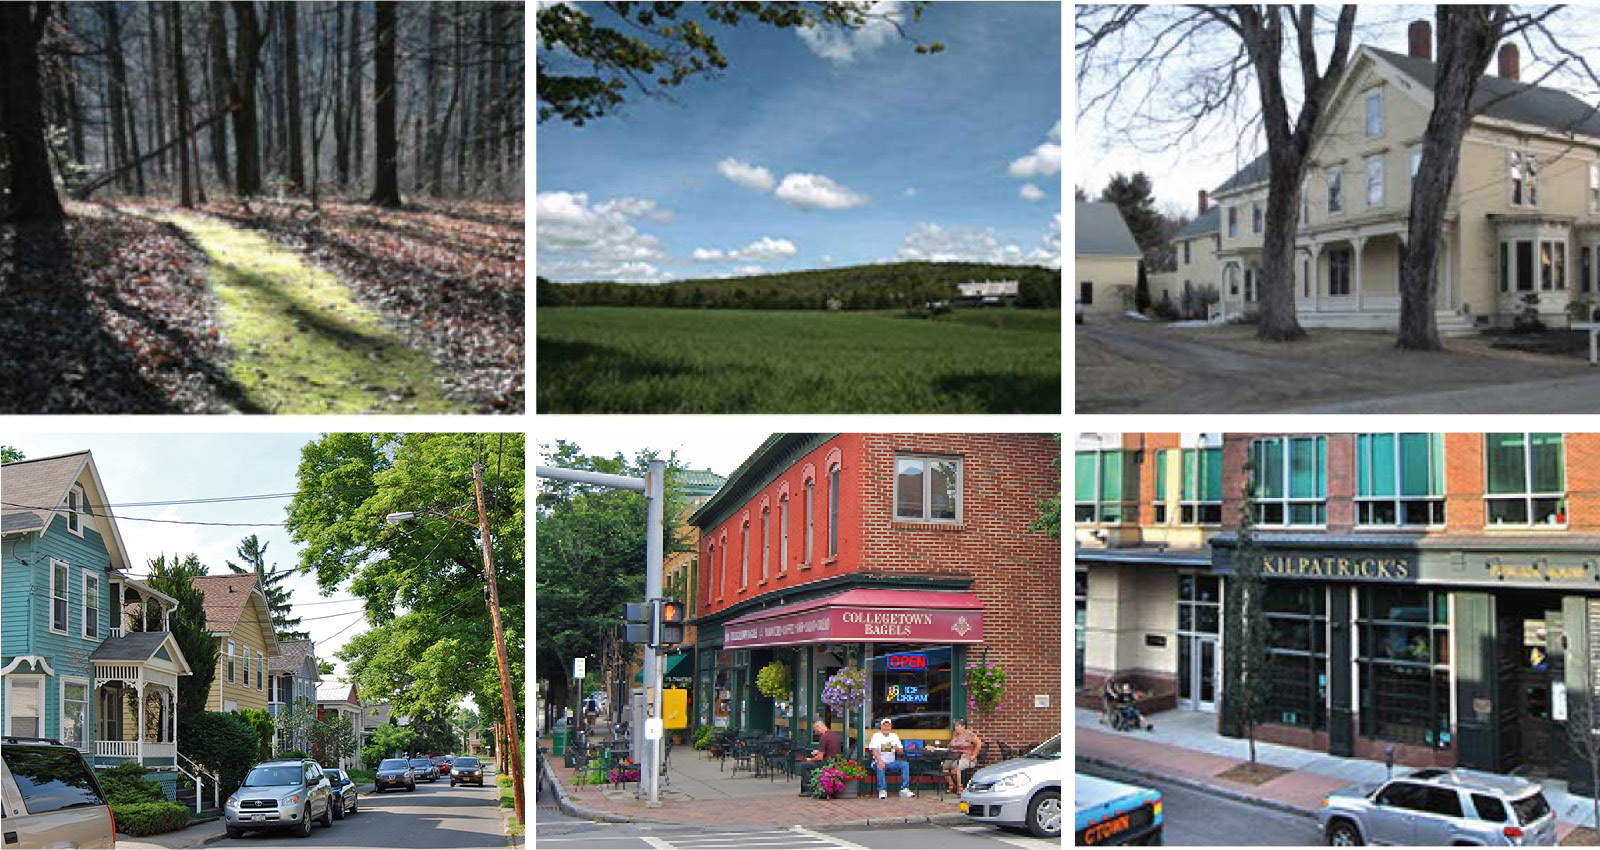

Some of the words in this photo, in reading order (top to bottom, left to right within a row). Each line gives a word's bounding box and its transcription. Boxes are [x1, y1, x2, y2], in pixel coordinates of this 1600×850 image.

[842, 612, 932, 624] COLLEGETOWN
[864, 624, 911, 635] BAGELS
[890, 656, 926, 668] OPEN
[904, 686, 918, 694] ICE
[896, 694, 928, 702] CREAM
